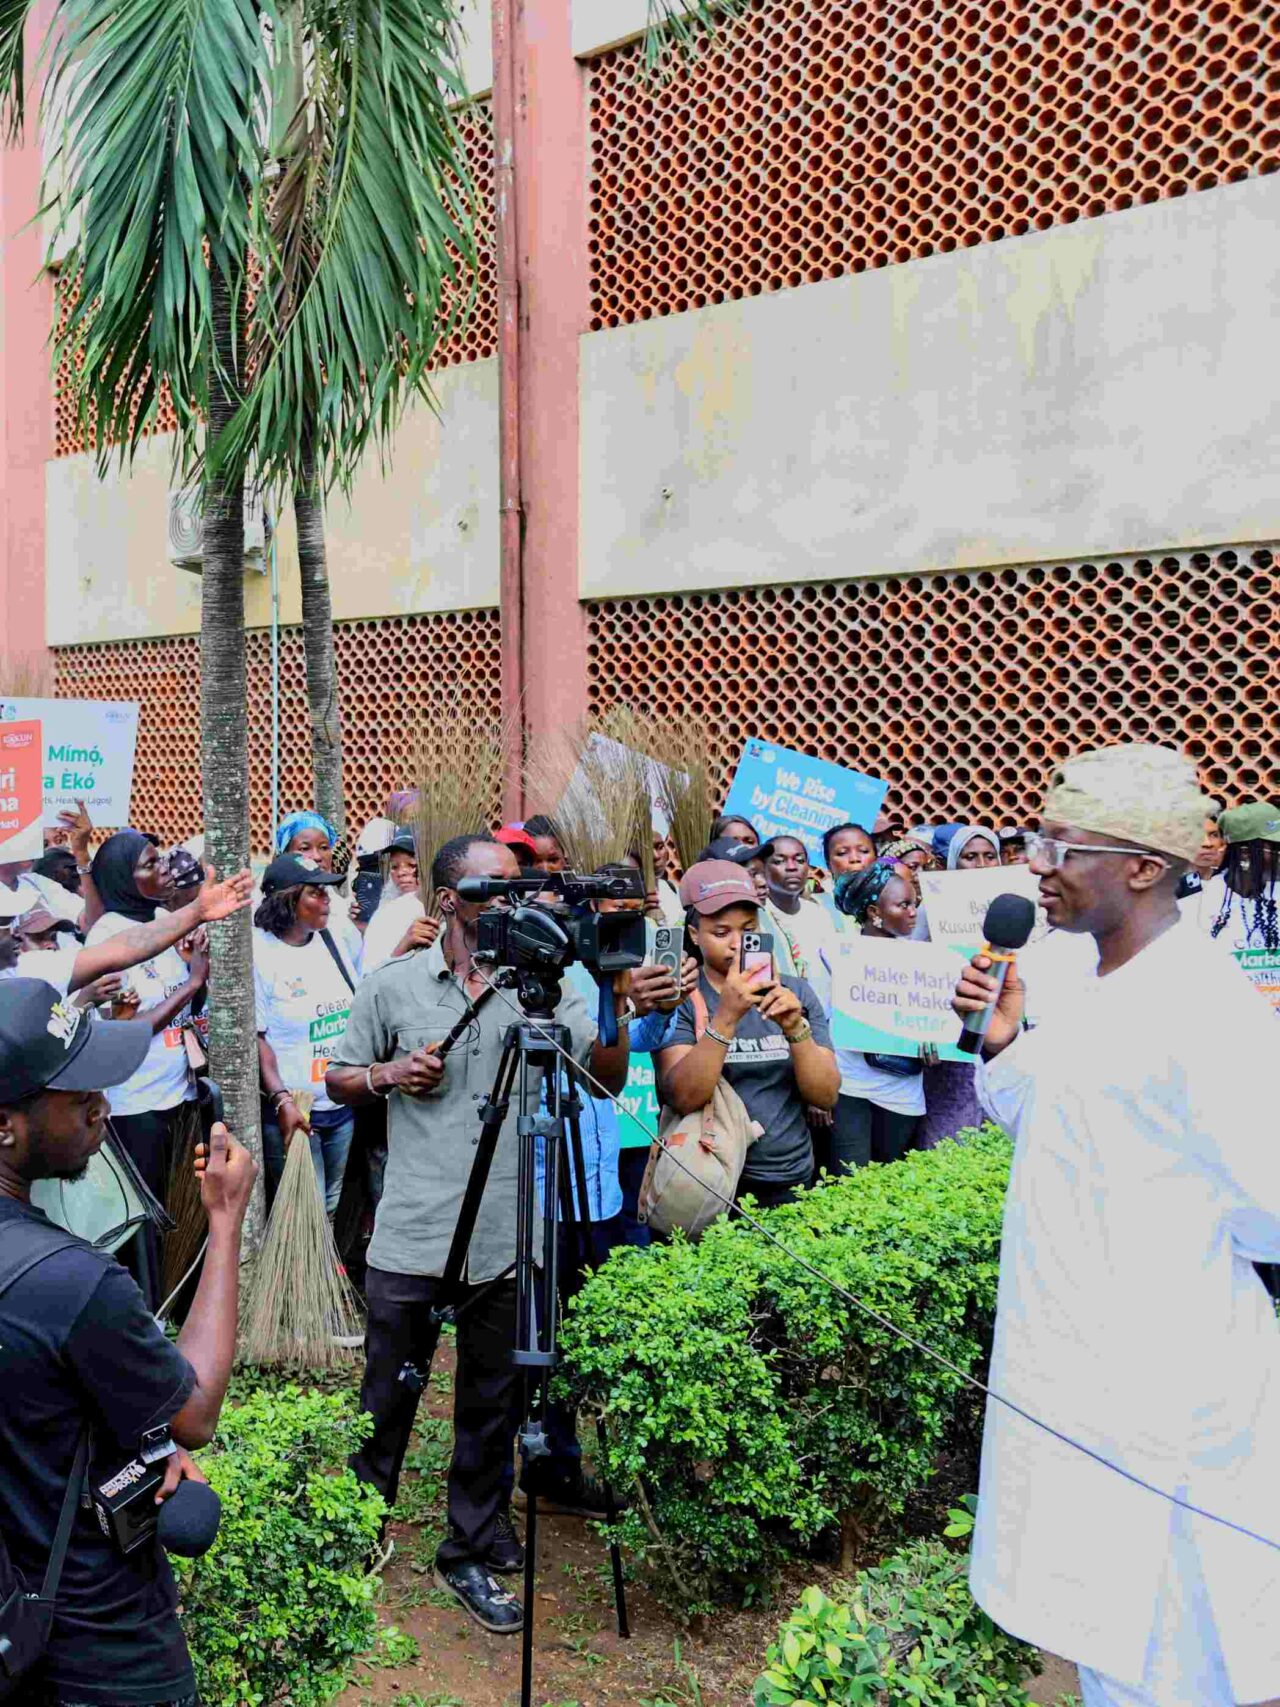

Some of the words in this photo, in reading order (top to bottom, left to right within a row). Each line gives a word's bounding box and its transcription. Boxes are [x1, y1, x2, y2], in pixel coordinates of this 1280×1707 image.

[61, 768, 96, 790] Èkó
[776, 767, 801, 790] We
[803, 776, 837, 803] Rise
[751, 784, 772, 811] by
[863, 965, 908, 986] Make
[315, 997, 349, 1017] Clean
[907, 991, 954, 1012] Make
[893, 1010, 948, 1032] Better
